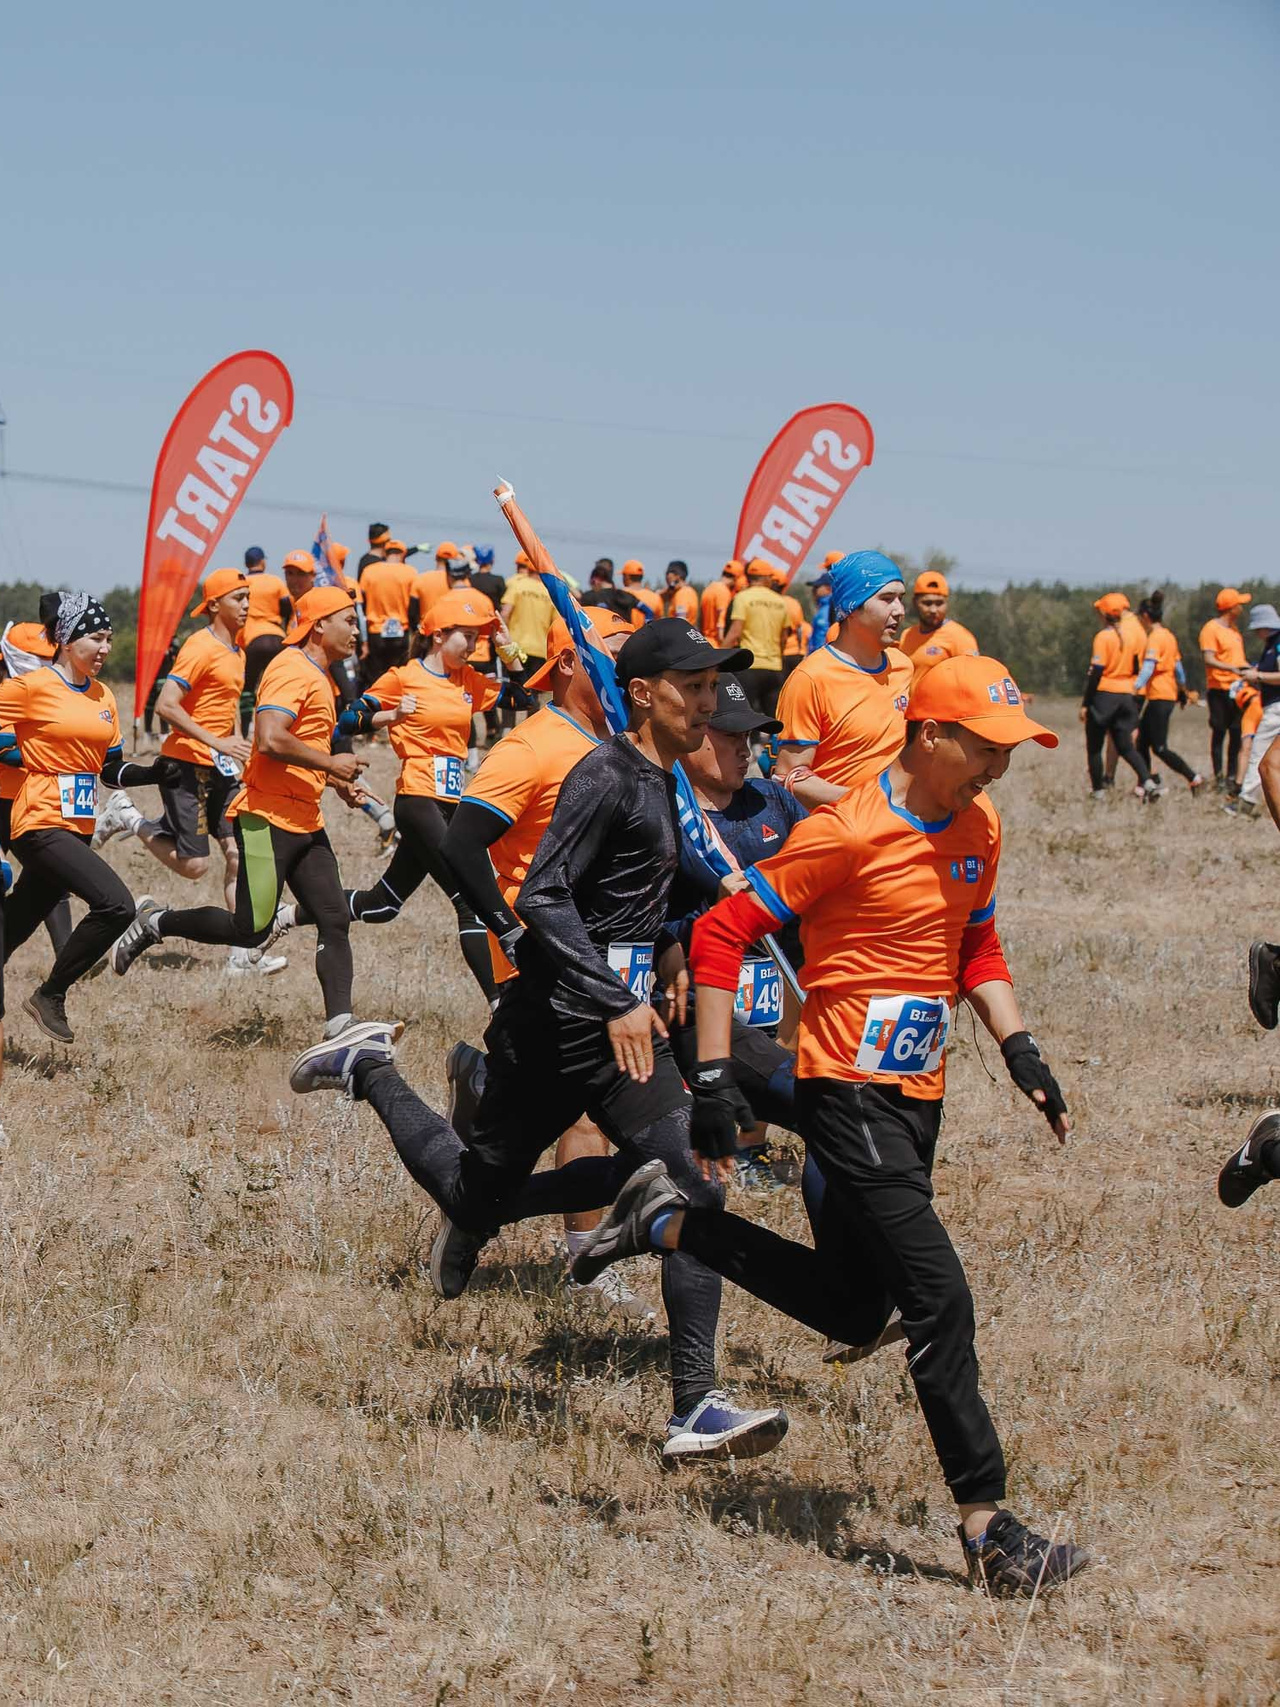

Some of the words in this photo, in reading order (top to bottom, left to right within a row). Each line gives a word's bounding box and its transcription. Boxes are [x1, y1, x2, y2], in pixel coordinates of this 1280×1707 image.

[76, 788, 95, 810] 44
[966, 860, 976, 868] BI
[636, 954, 646, 964] BI
[761, 968, 771, 979] BI
[756, 982, 779, 1014] 49
[909, 1008, 927, 1022] BI
[893, 1027, 936, 1061] 64
